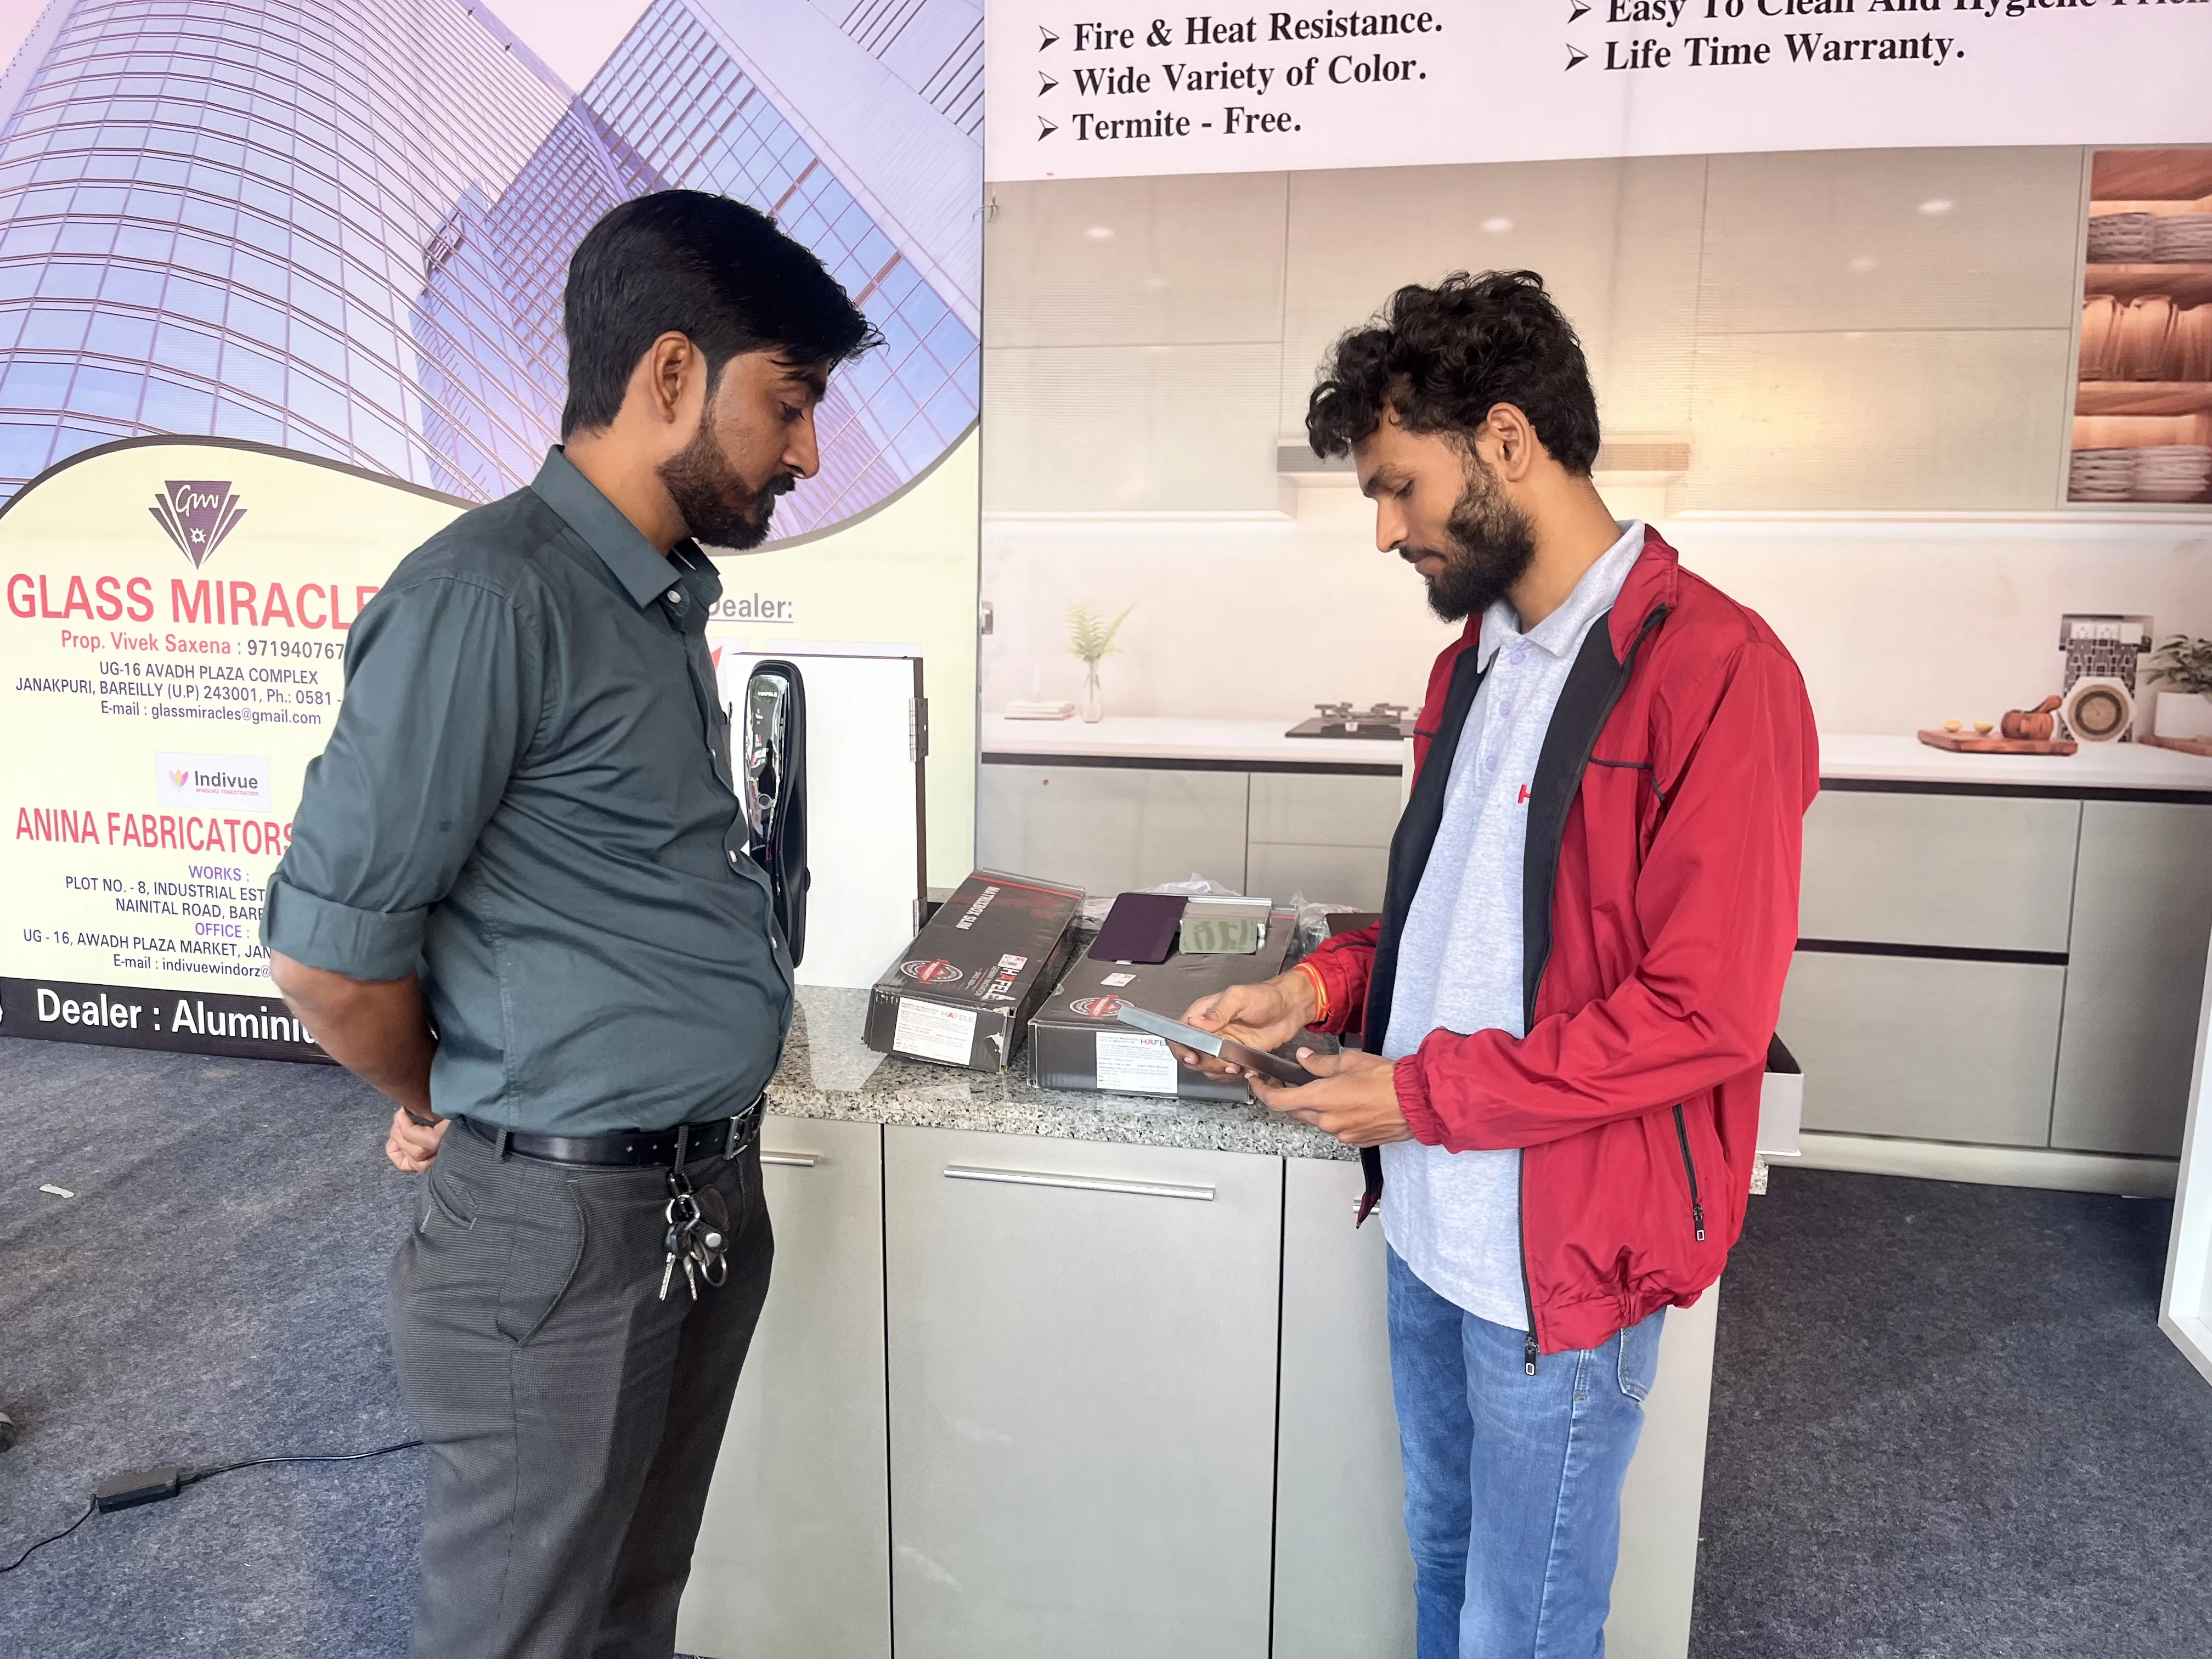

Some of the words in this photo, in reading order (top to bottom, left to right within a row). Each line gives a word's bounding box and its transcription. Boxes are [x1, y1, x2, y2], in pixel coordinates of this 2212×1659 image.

[1607, 0, 1686, 27] Easy
[1705, 0, 1743, 18] To
[1074, 22, 1133, 51] Fire
[1147, 19, 1172, 47] &
[1185, 16, 1256, 44] Heat
[1268, 10, 1442, 41] Resistance.
[1605, 40, 1671, 70] Life
[1685, 37, 1770, 66] Time
[1785, 32, 1965, 66] Warranty.
[1073, 67, 1150, 95] Wide
[1162, 62, 1274, 95] Variety
[1286, 57, 1318, 86] of
[1329, 54, 1425, 83] Color.
[1073, 110, 1189, 140] Termite
[1224, 107, 1300, 134] Free.
[8, 574, 154, 622] GLASS
[61, 630, 104, 652] Prop.
[110, 632, 159, 651] Vivek
[166, 634, 230, 654] Saxena
[238, 642, 241, 654] :
[248, 640, 344, 659] 971940767
[100, 662, 140, 676] UG-16
[145, 664, 194, 678] AVADH
[200, 666, 244, 680] PLAZA
[249, 668, 318, 684] COMPLEX
[16, 678, 95, 695] JANAKPURI,
[100, 681, 162, 696] BAREILLY
[168, 684, 199, 701] (U.P)
[204, 686, 262, 703] 243001,
[267, 689, 291, 703] Ph.:
[296, 690, 330, 705] 0581
[101, 701, 139, 715] E-mail
[144, 705, 148, 716] :
[152, 703, 320, 724] glassmiracles@gmail.com
[195, 771, 257, 789] Indivue
[16, 808, 99, 844] ANINA
[189, 866, 241, 881] WORKS
[246, 872, 250, 881] :
[66, 876, 98, 890] PLOT
[103, 879, 126, 892] NO.
[138, 881, 149, 895] 8,
[154, 882, 236, 899] INDUSTRIAL
[240, 888, 265, 901] EST
[966, 886, 1000, 916] MATRIXBOX
[116, 899, 178, 915] NAINITAL
[183, 903, 224, 919] ROAD,
[955, 915, 977, 930] SLIM
[24, 929, 41, 942] UG
[54, 932, 72, 945] 16,
[77, 933, 128, 948] AWADH
[134, 937, 176, 952] PLAZA
[180, 940, 240, 958] MARKET,
[195, 923, 241, 938] OFFICE
[246, 929, 250, 939] :
[114, 954, 150, 968] E-mail
[155, 961, 158, 969] :
[163, 958, 269, 977] indivuewindorz@
[37, 989, 142, 1028] Dealer
[154, 1008, 160, 1030] :
